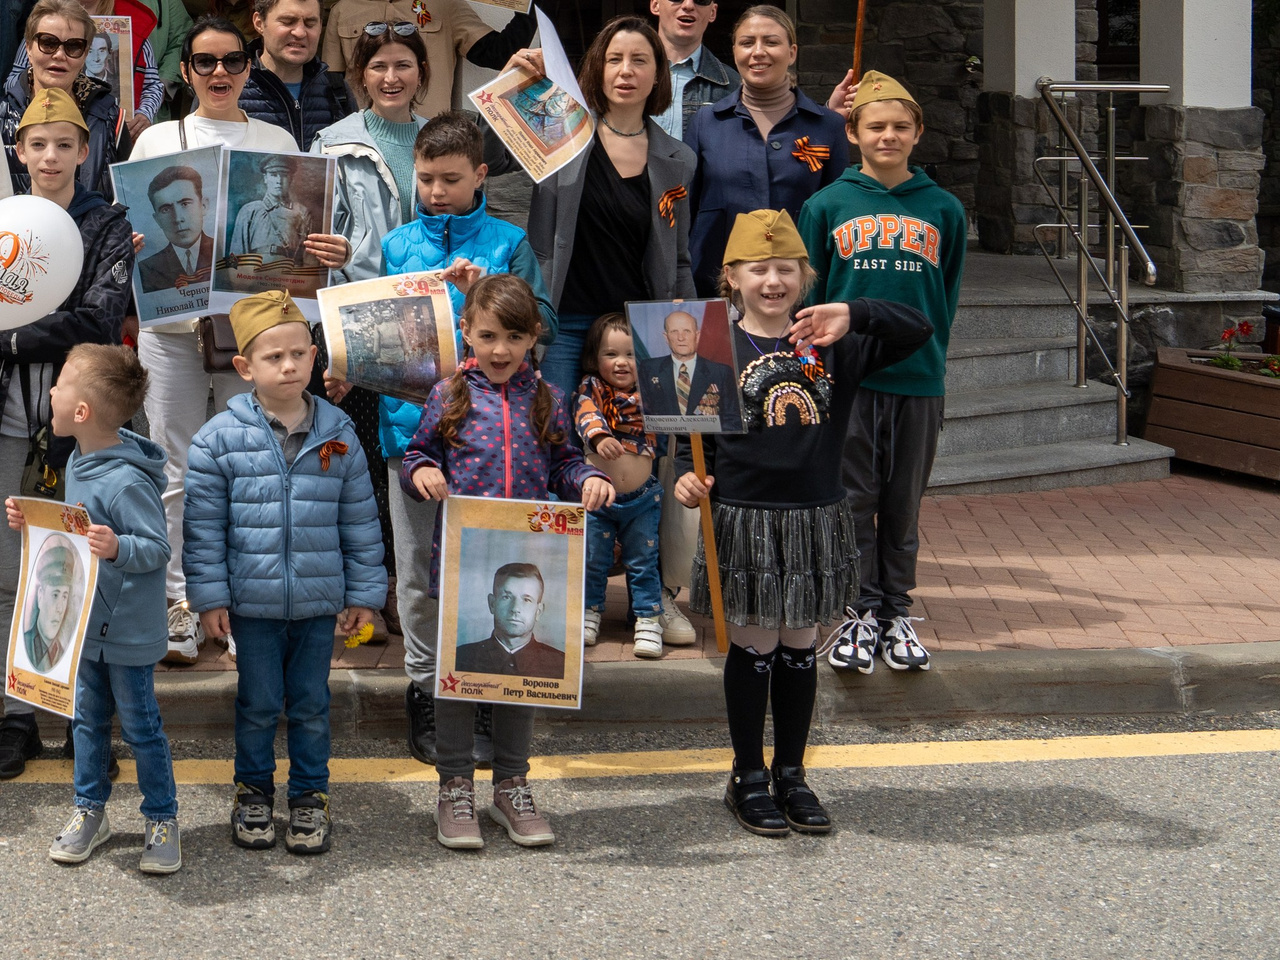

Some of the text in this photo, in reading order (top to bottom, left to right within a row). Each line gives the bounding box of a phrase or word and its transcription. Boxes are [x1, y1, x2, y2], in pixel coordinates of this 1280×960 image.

[832, 213, 941, 269] UPPER
[854, 259, 923, 272] EAST SIDE
[417, 280, 429, 295] 9
[156, 298, 209, 316] Николай Пе
[679, 416, 717, 424] Александр
[555, 513, 567, 534] 9
[522, 678, 559, 689] Воронов
[460, 687, 483, 696] ПОЛК
[503, 687, 577, 701] Петр Васильевич
